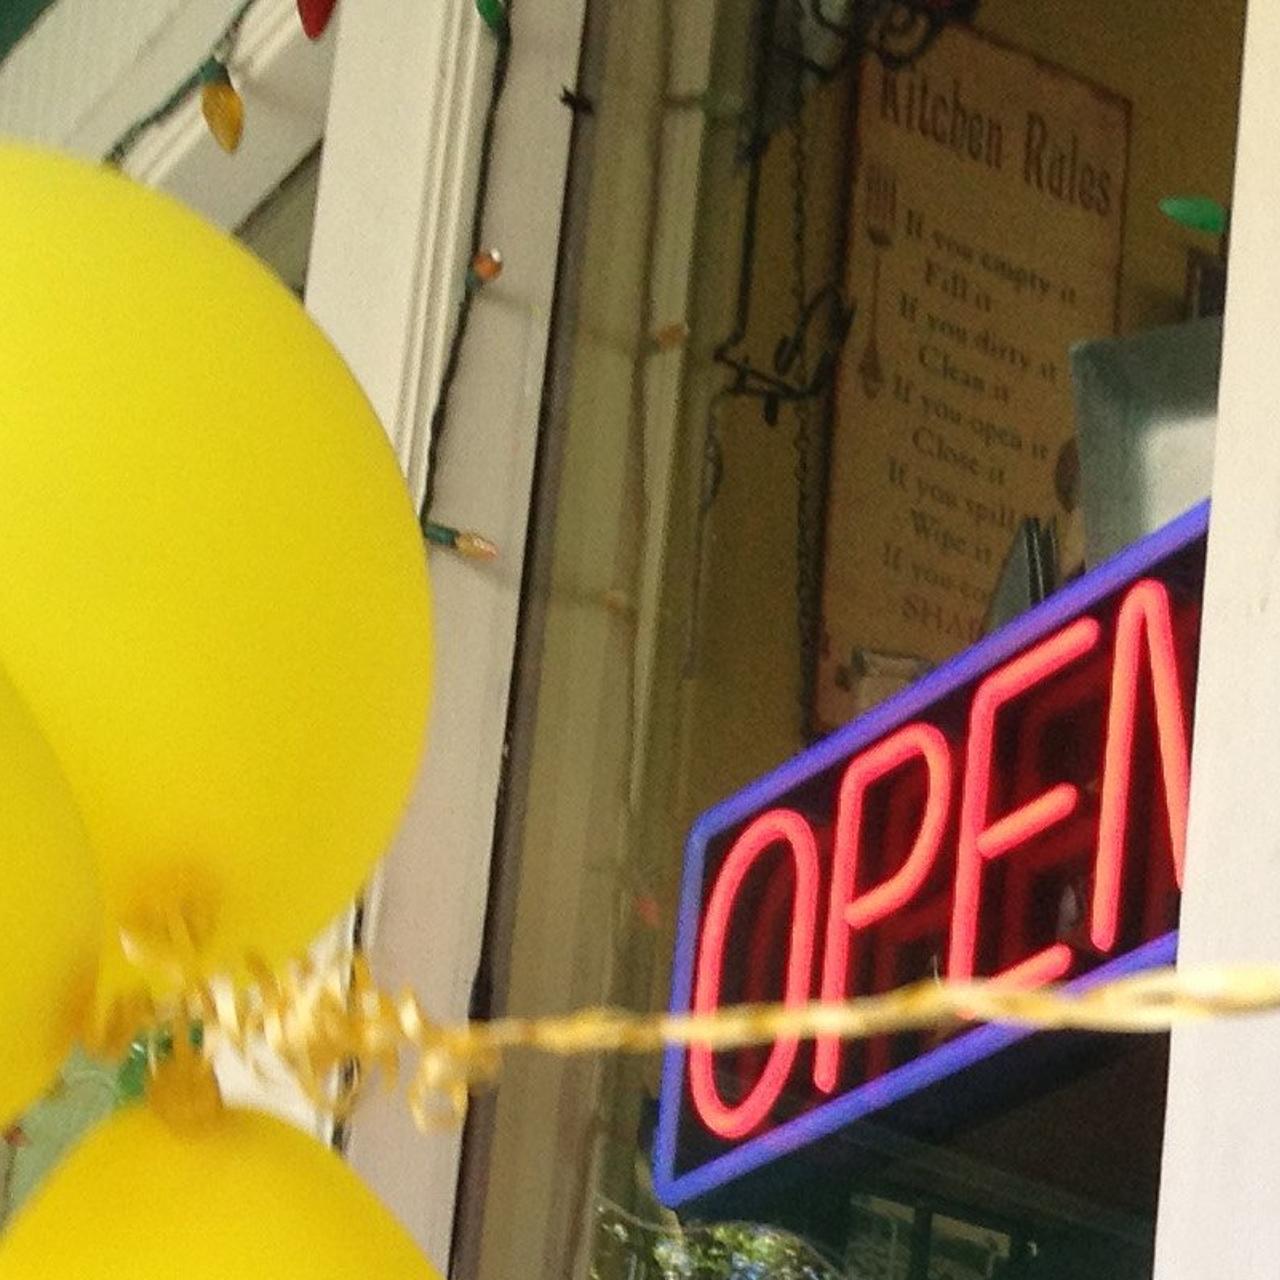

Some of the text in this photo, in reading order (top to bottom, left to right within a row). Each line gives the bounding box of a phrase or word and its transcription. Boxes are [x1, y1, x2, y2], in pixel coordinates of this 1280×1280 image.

[880, 70, 1111, 217] Kitchen Rules
[919, 340, 986, 394] Clean
[927, 312, 967, 348] you
[975, 324, 1030, 373] dirty
[894, 374, 913, 406] If
[921, 394, 961, 430] you
[970, 414, 1022, 460] open
[889, 456, 908, 491] If
[918, 476, 957, 513] you
[913, 423, 1006, 487] Close it
[910, 508, 967, 559] Wipe
[692, 580, 1191, 1137] OPEN
